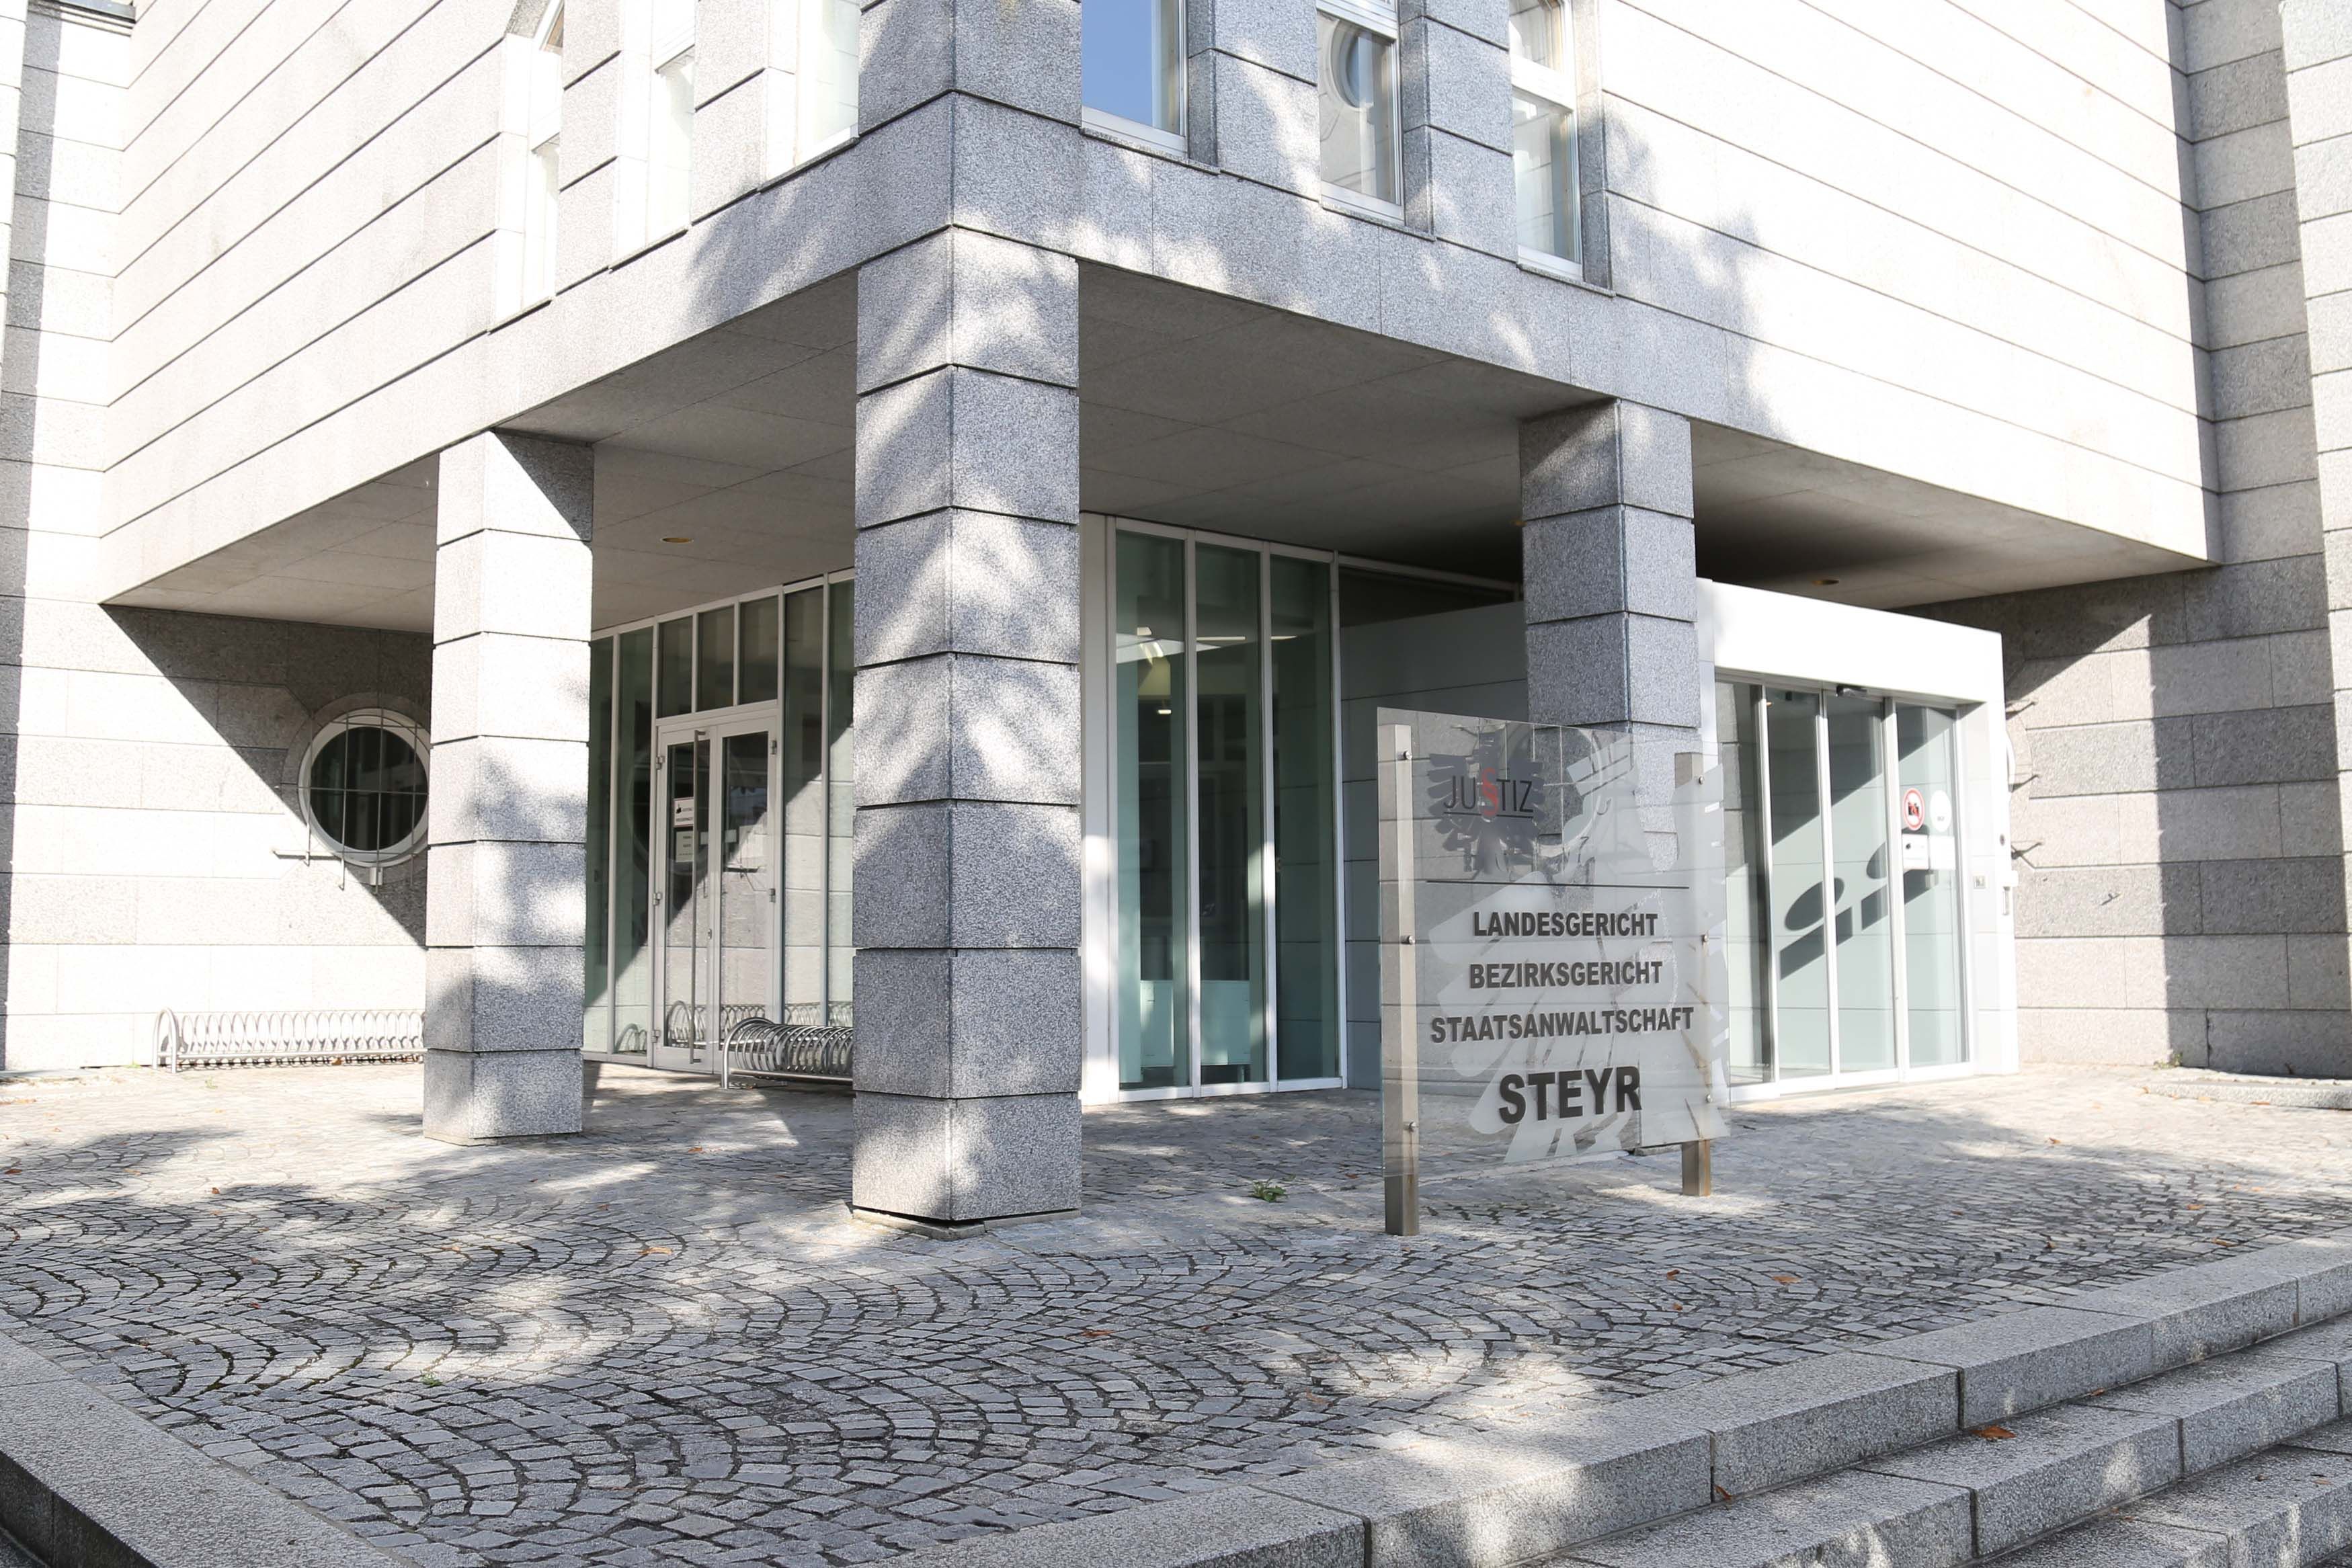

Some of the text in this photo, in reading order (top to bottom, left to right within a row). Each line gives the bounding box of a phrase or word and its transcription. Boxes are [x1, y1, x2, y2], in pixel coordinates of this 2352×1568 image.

[1473, 911, 1658, 936] LANDESGERICHT
[1469, 961, 1662, 989] BEZIRKSGERICHT
[1431, 1007, 1694, 1043] STAATSANWALTSCHAFT
[1499, 1066, 1642, 1124] STEYR
